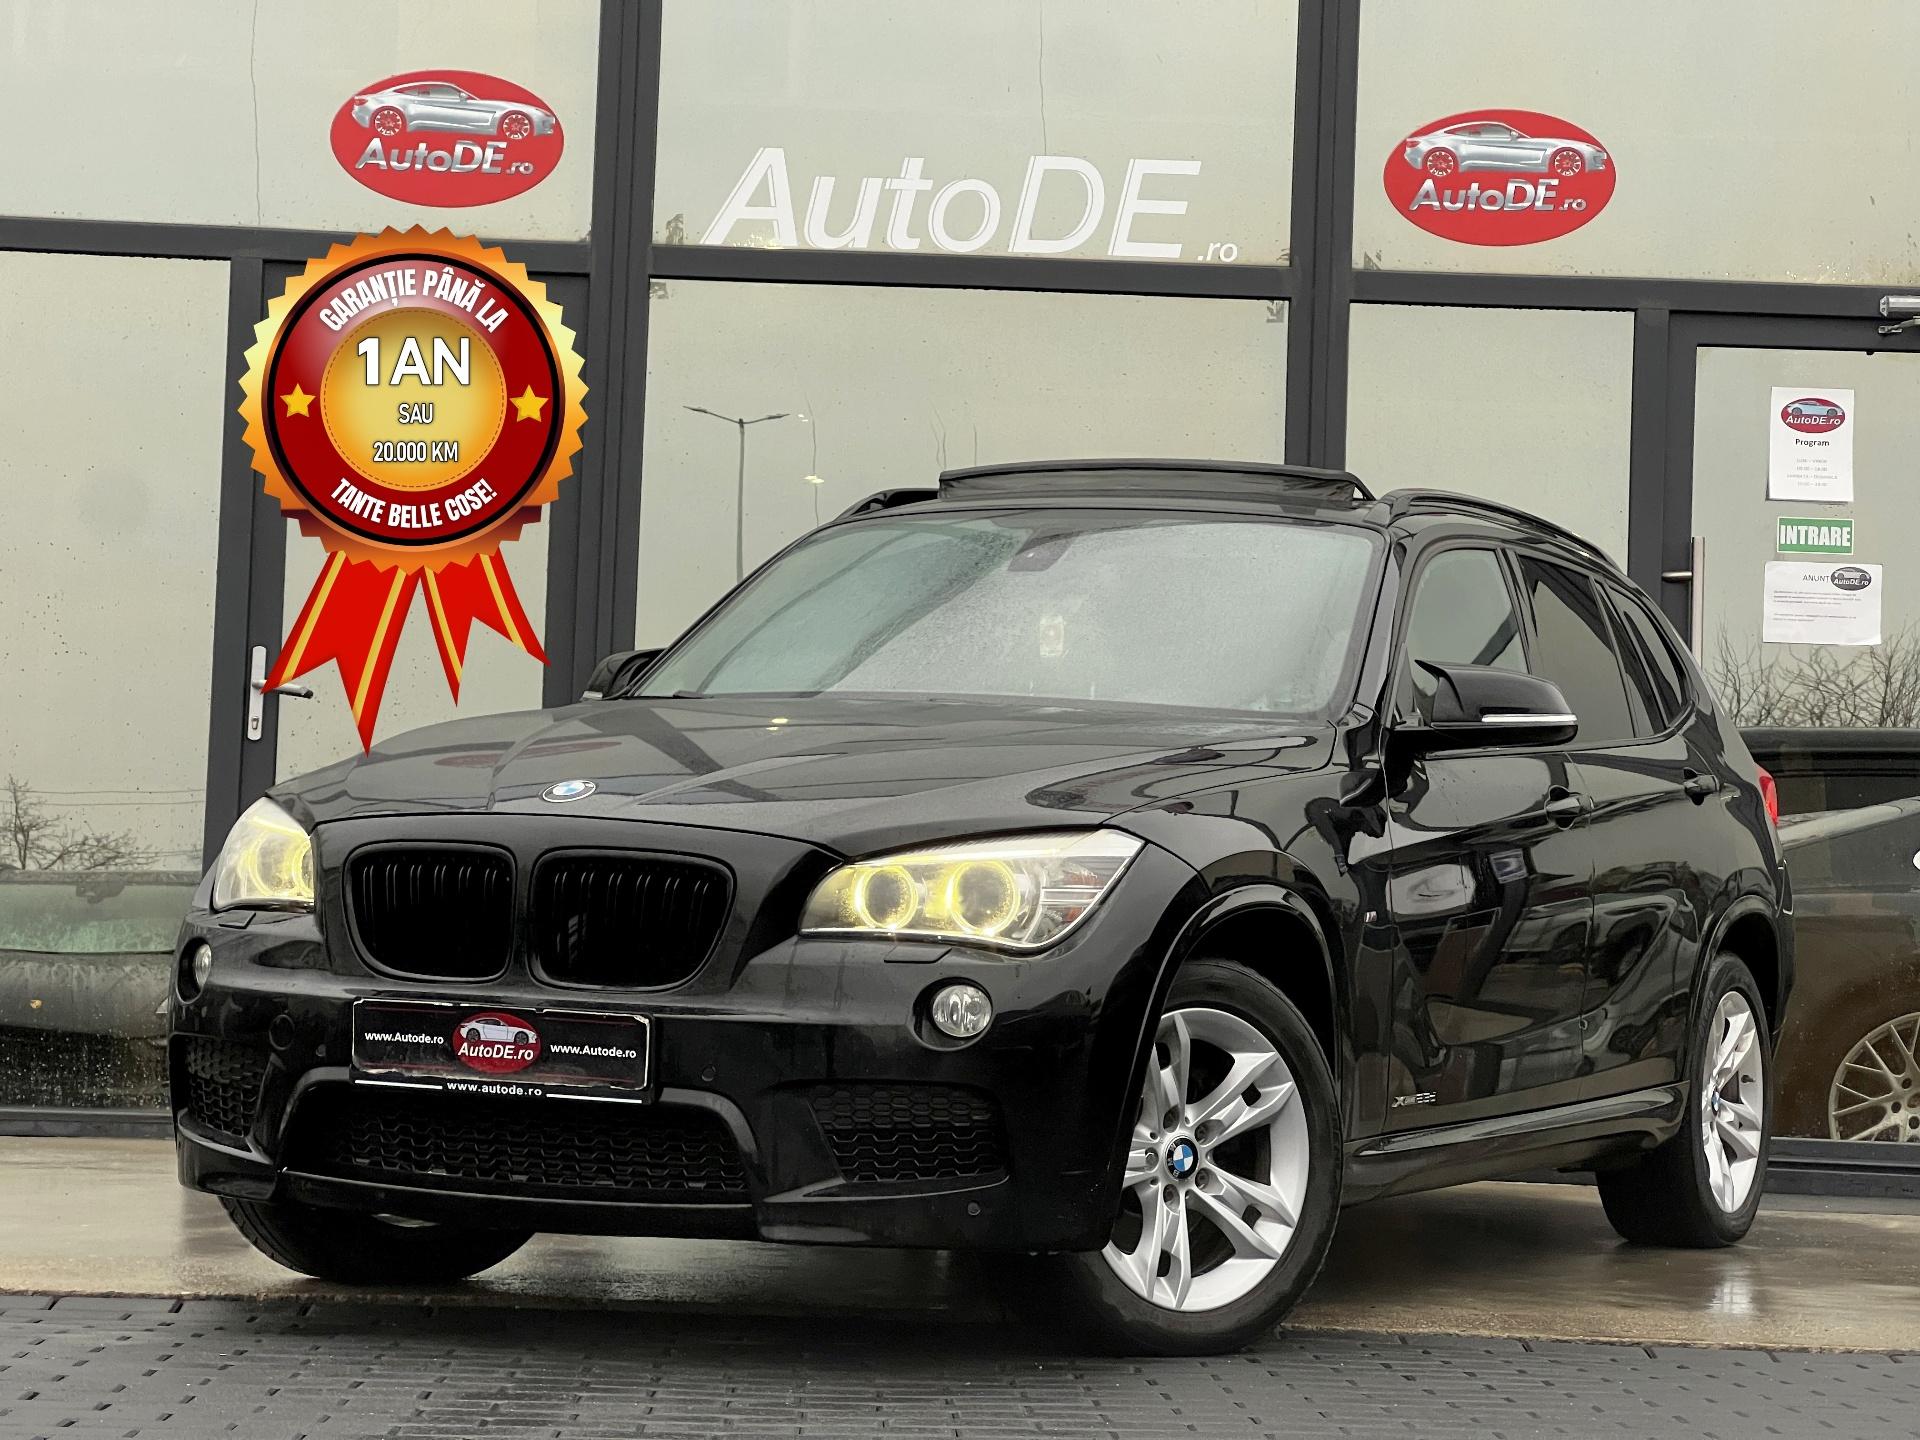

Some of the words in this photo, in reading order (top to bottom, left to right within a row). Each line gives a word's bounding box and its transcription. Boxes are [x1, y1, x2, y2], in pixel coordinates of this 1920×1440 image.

[1785, 415, 1842, 426] AutoDE.ro
[1795, 438, 1830, 447] Program
[1779, 524, 1851, 548] INTRARE
[1803, 574, 1830, 582] ANUNT
[364, 1030, 444, 1045] www.Autode.ro
[457, 1042, 534, 1061] AutoDE.ro
[549, 1043, 637, 1059] www.Autode.ro
[446, 1081, 542, 1097] www.autode.ro
